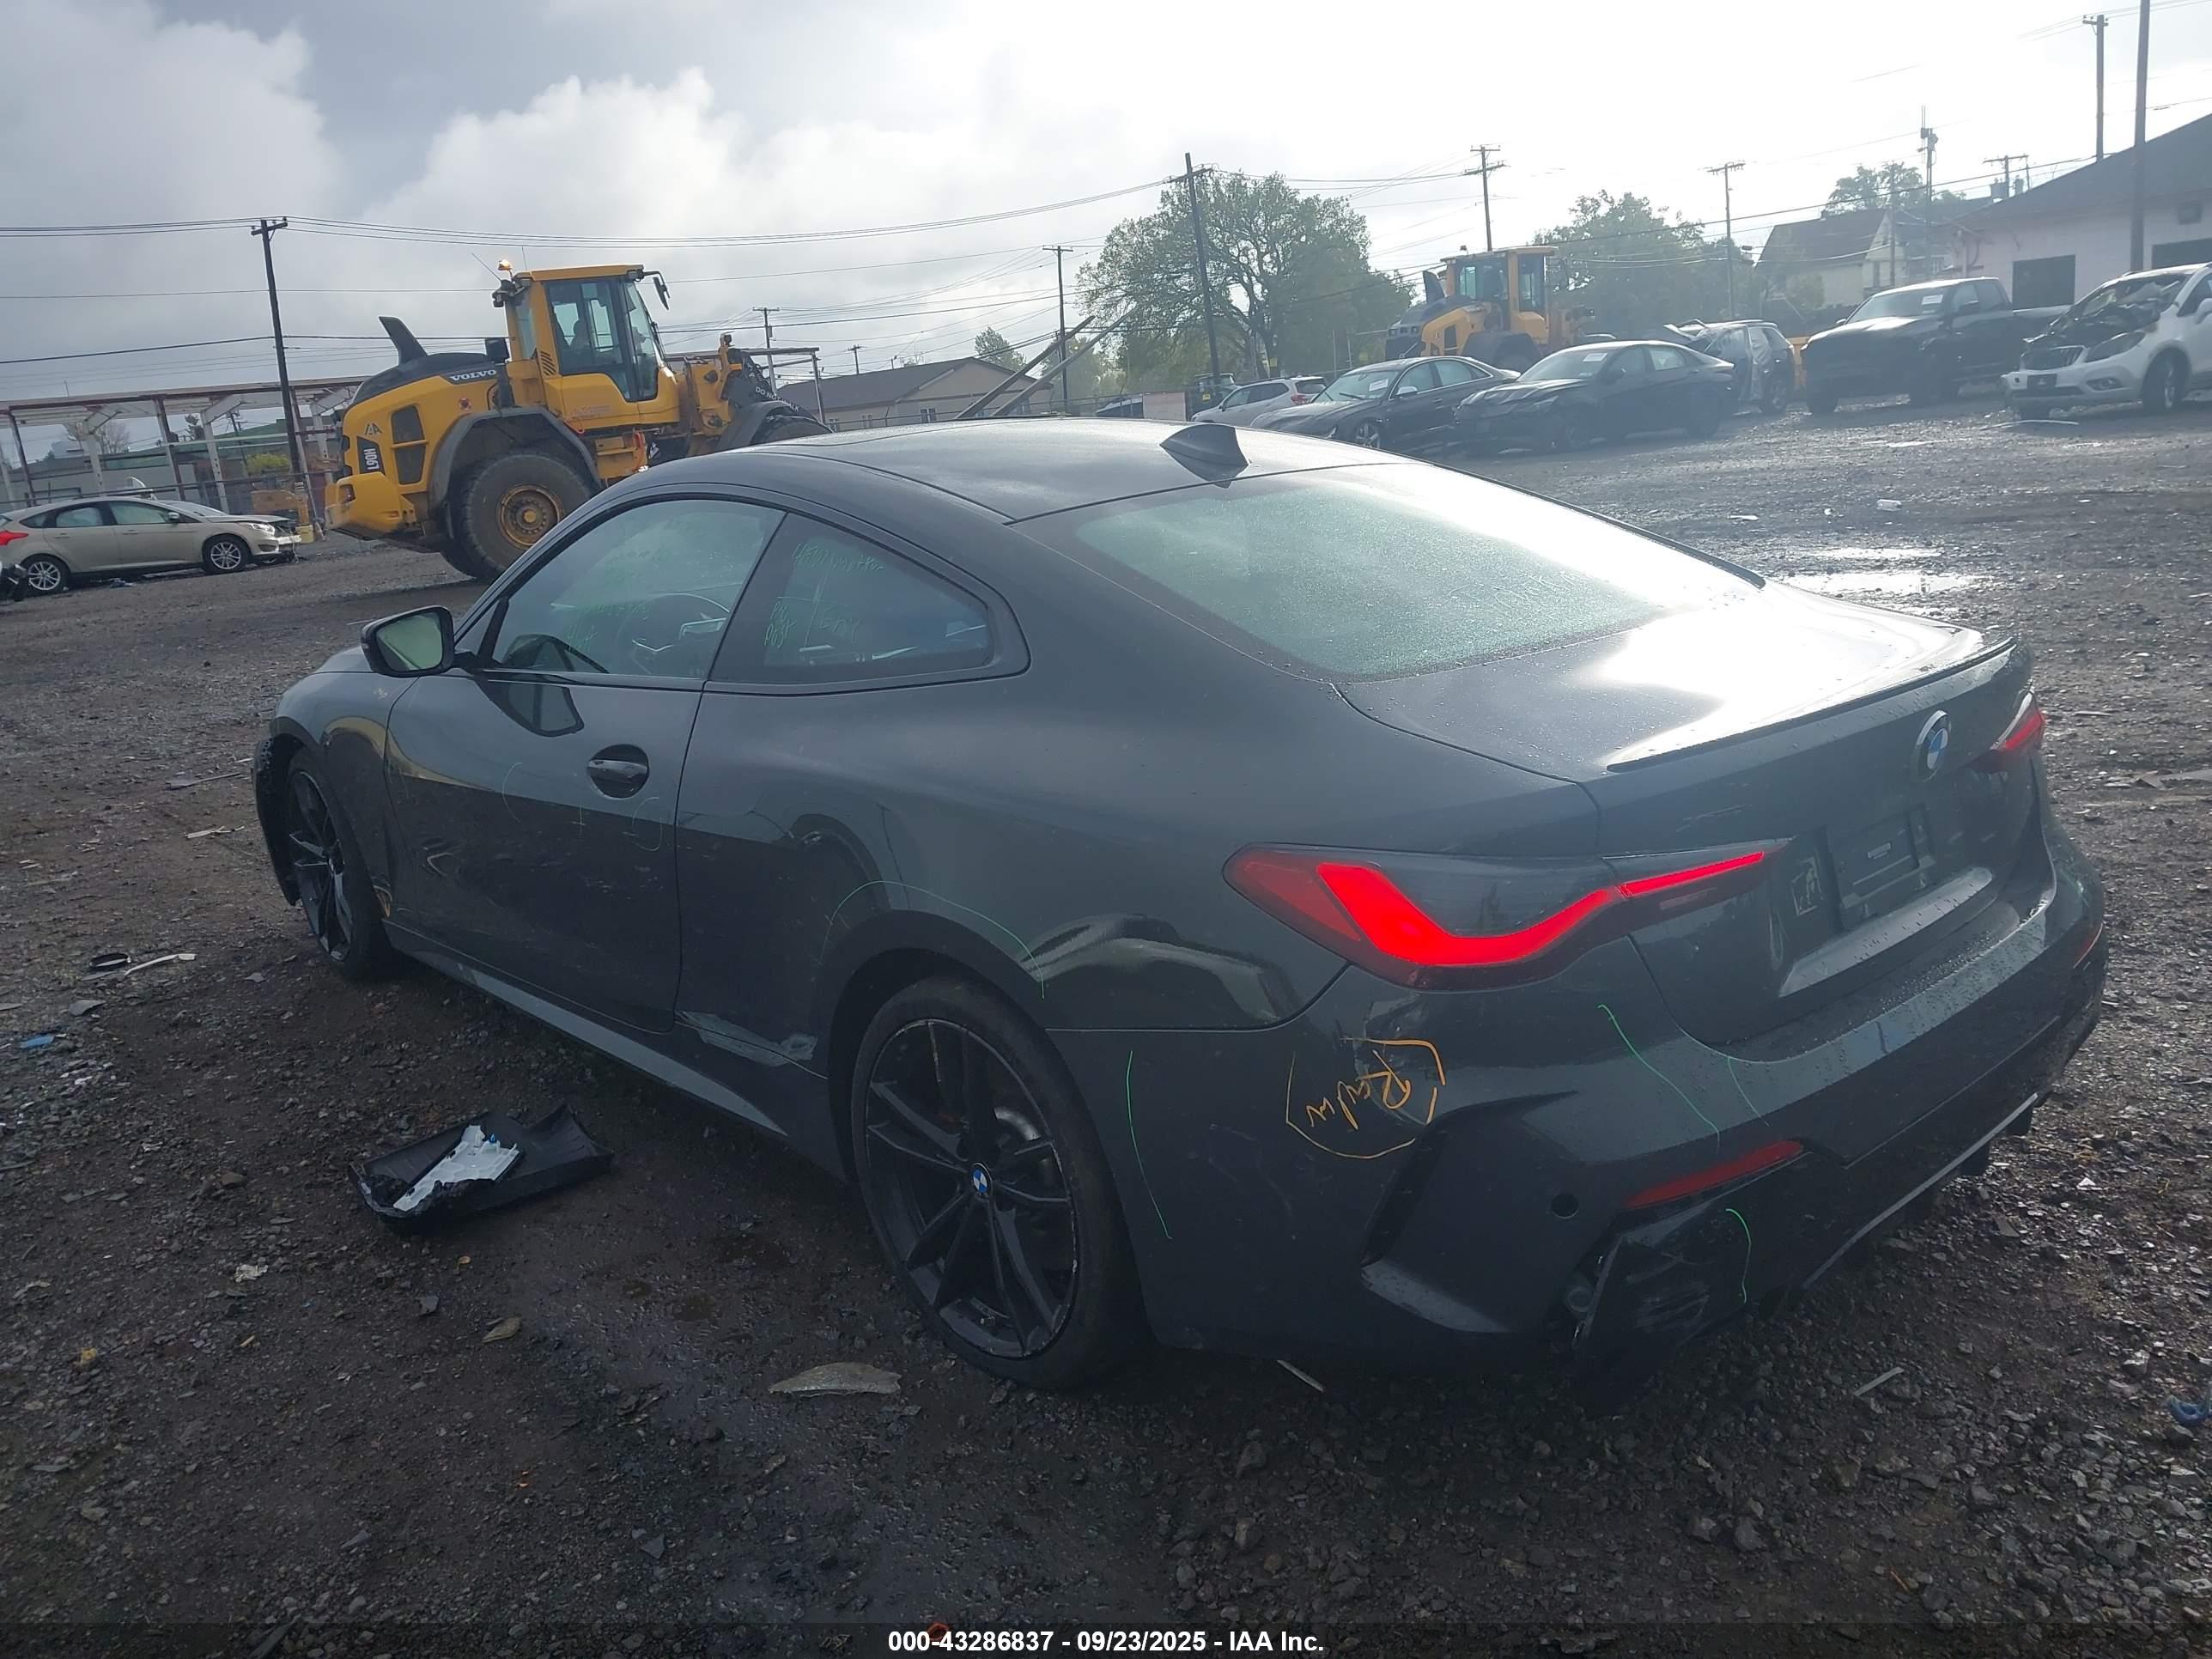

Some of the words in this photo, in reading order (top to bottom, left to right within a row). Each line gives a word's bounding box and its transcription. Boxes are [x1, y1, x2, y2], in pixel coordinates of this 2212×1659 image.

[448, 369, 497, 381] VOLVO
[756, 386, 766, 395] DO
[766, 392, 781, 400] NOT
[363, 448, 380, 470] L90H
